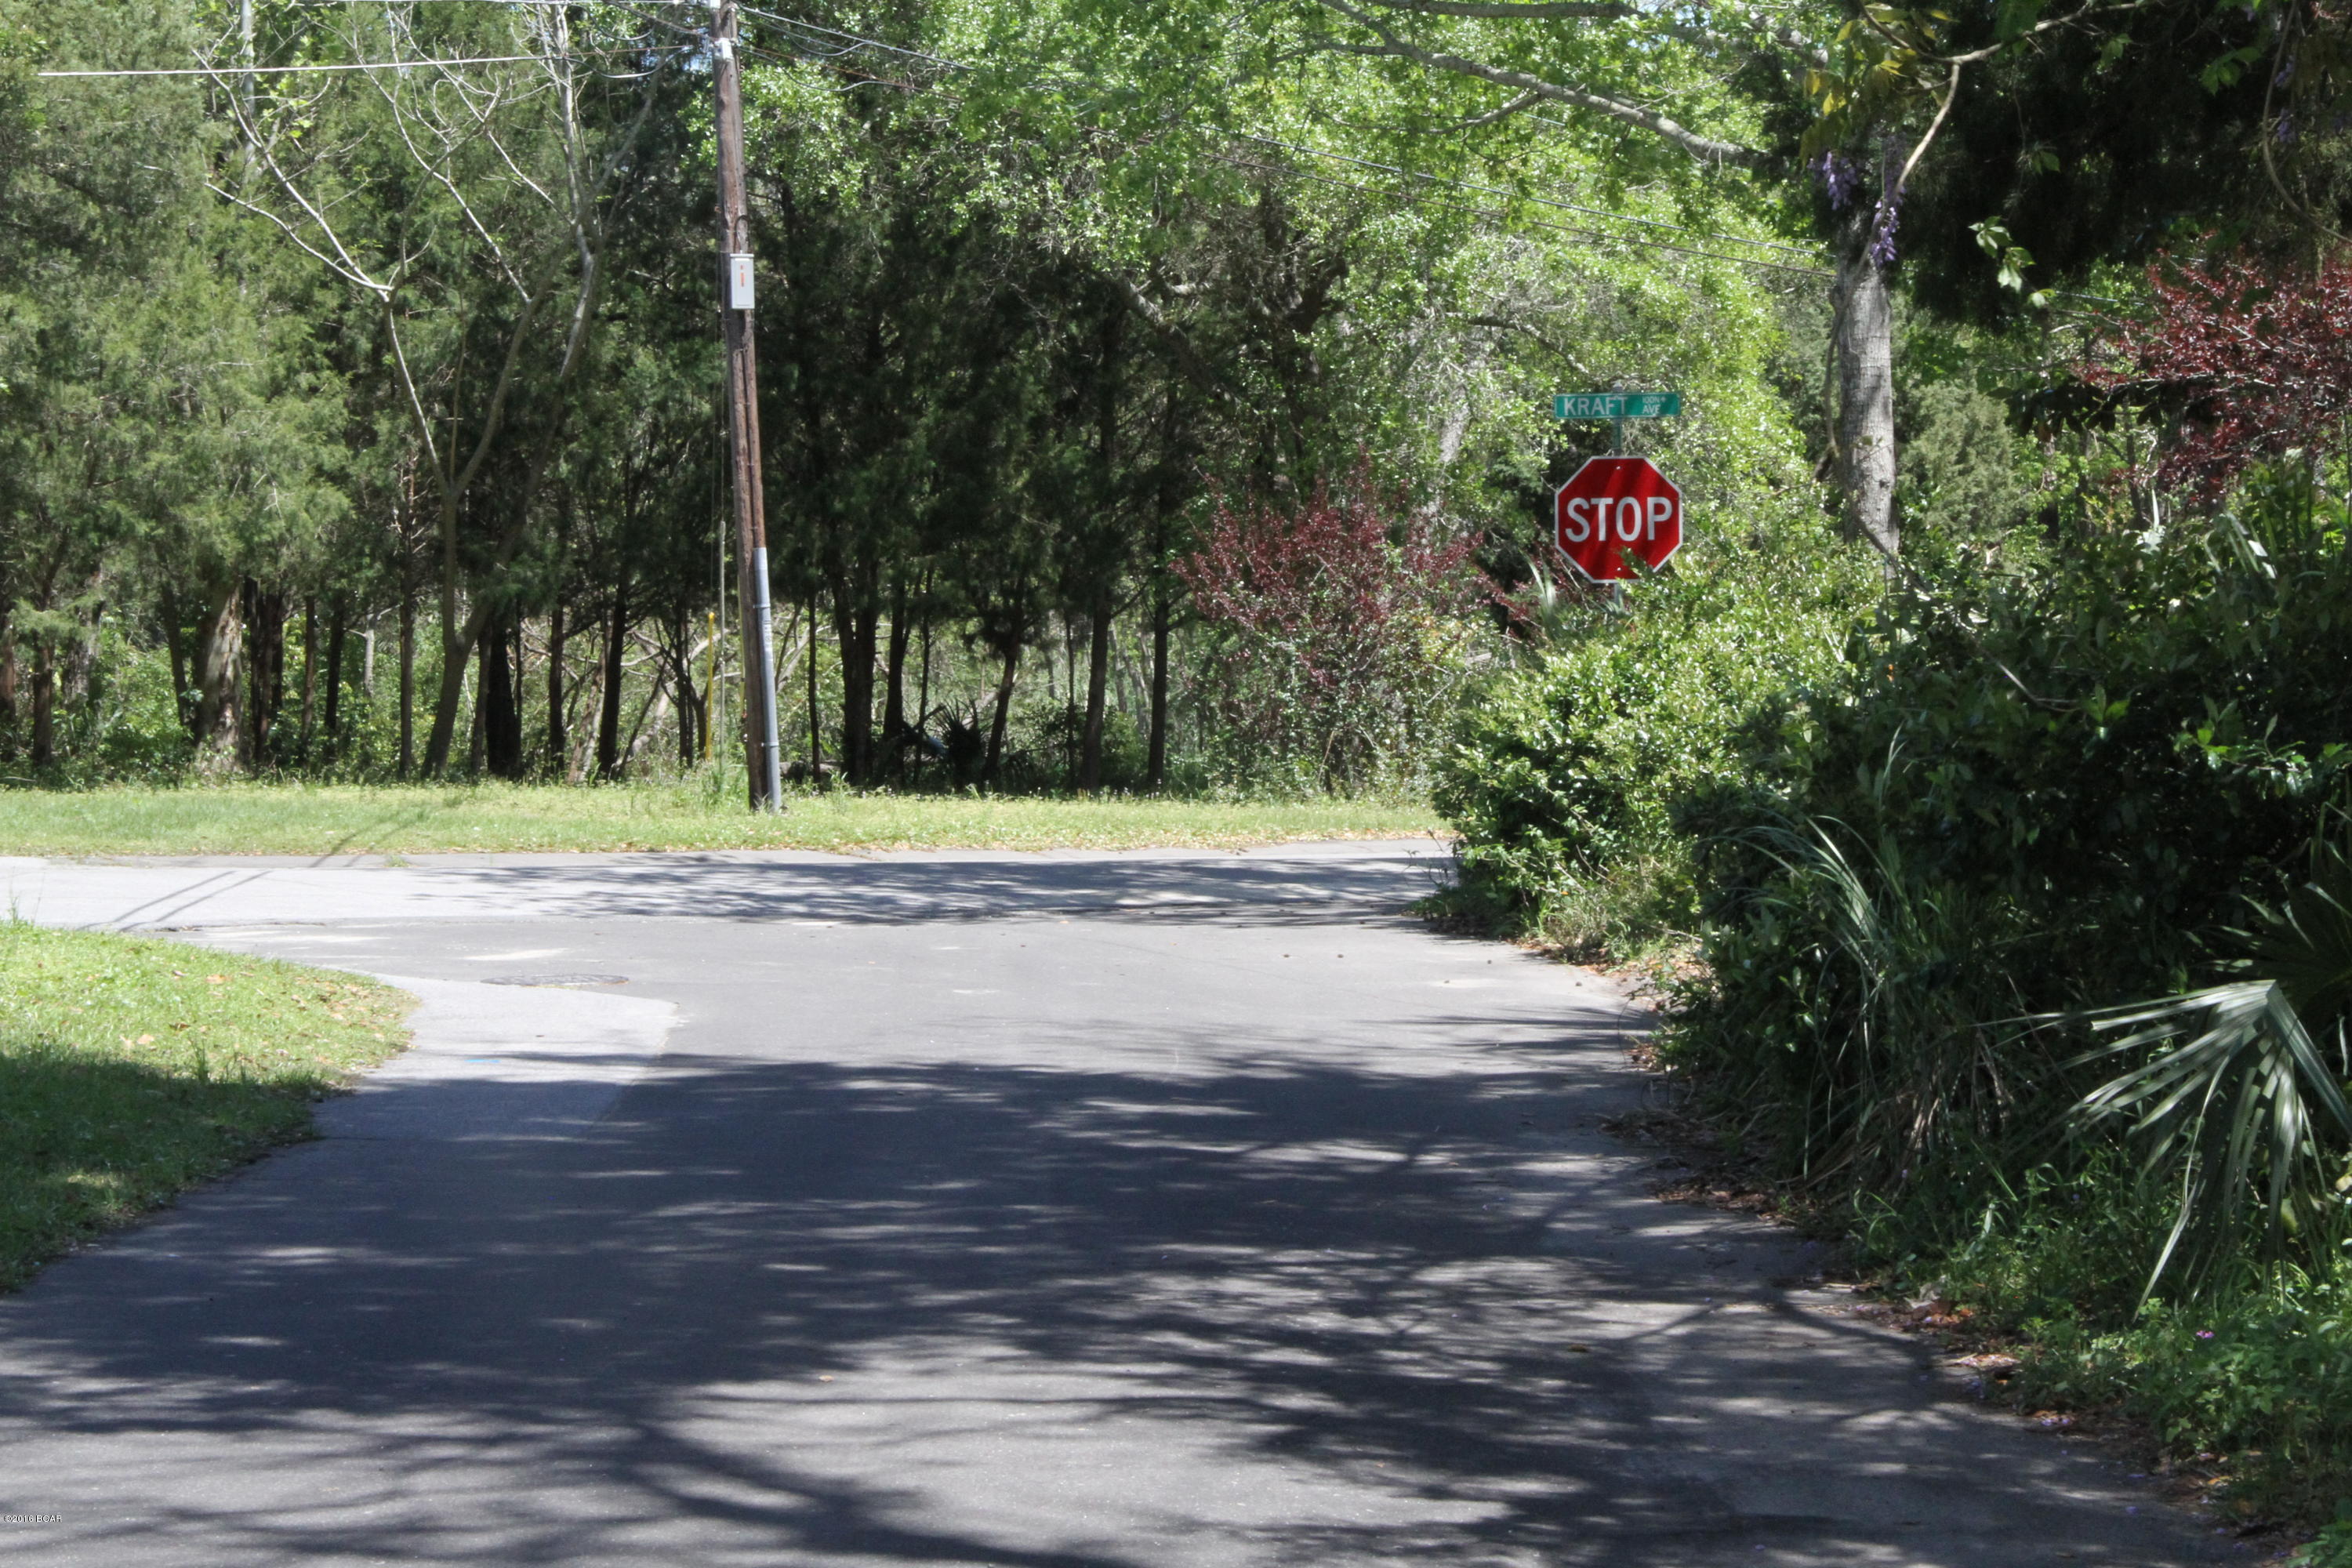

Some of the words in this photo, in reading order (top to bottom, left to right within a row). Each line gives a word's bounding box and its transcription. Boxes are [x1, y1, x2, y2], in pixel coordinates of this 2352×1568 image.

[1564, 397, 1628, 416] KRAFT
[1642, 404, 1661, 414] AVE
[1565, 496, 1672, 543] STOP
